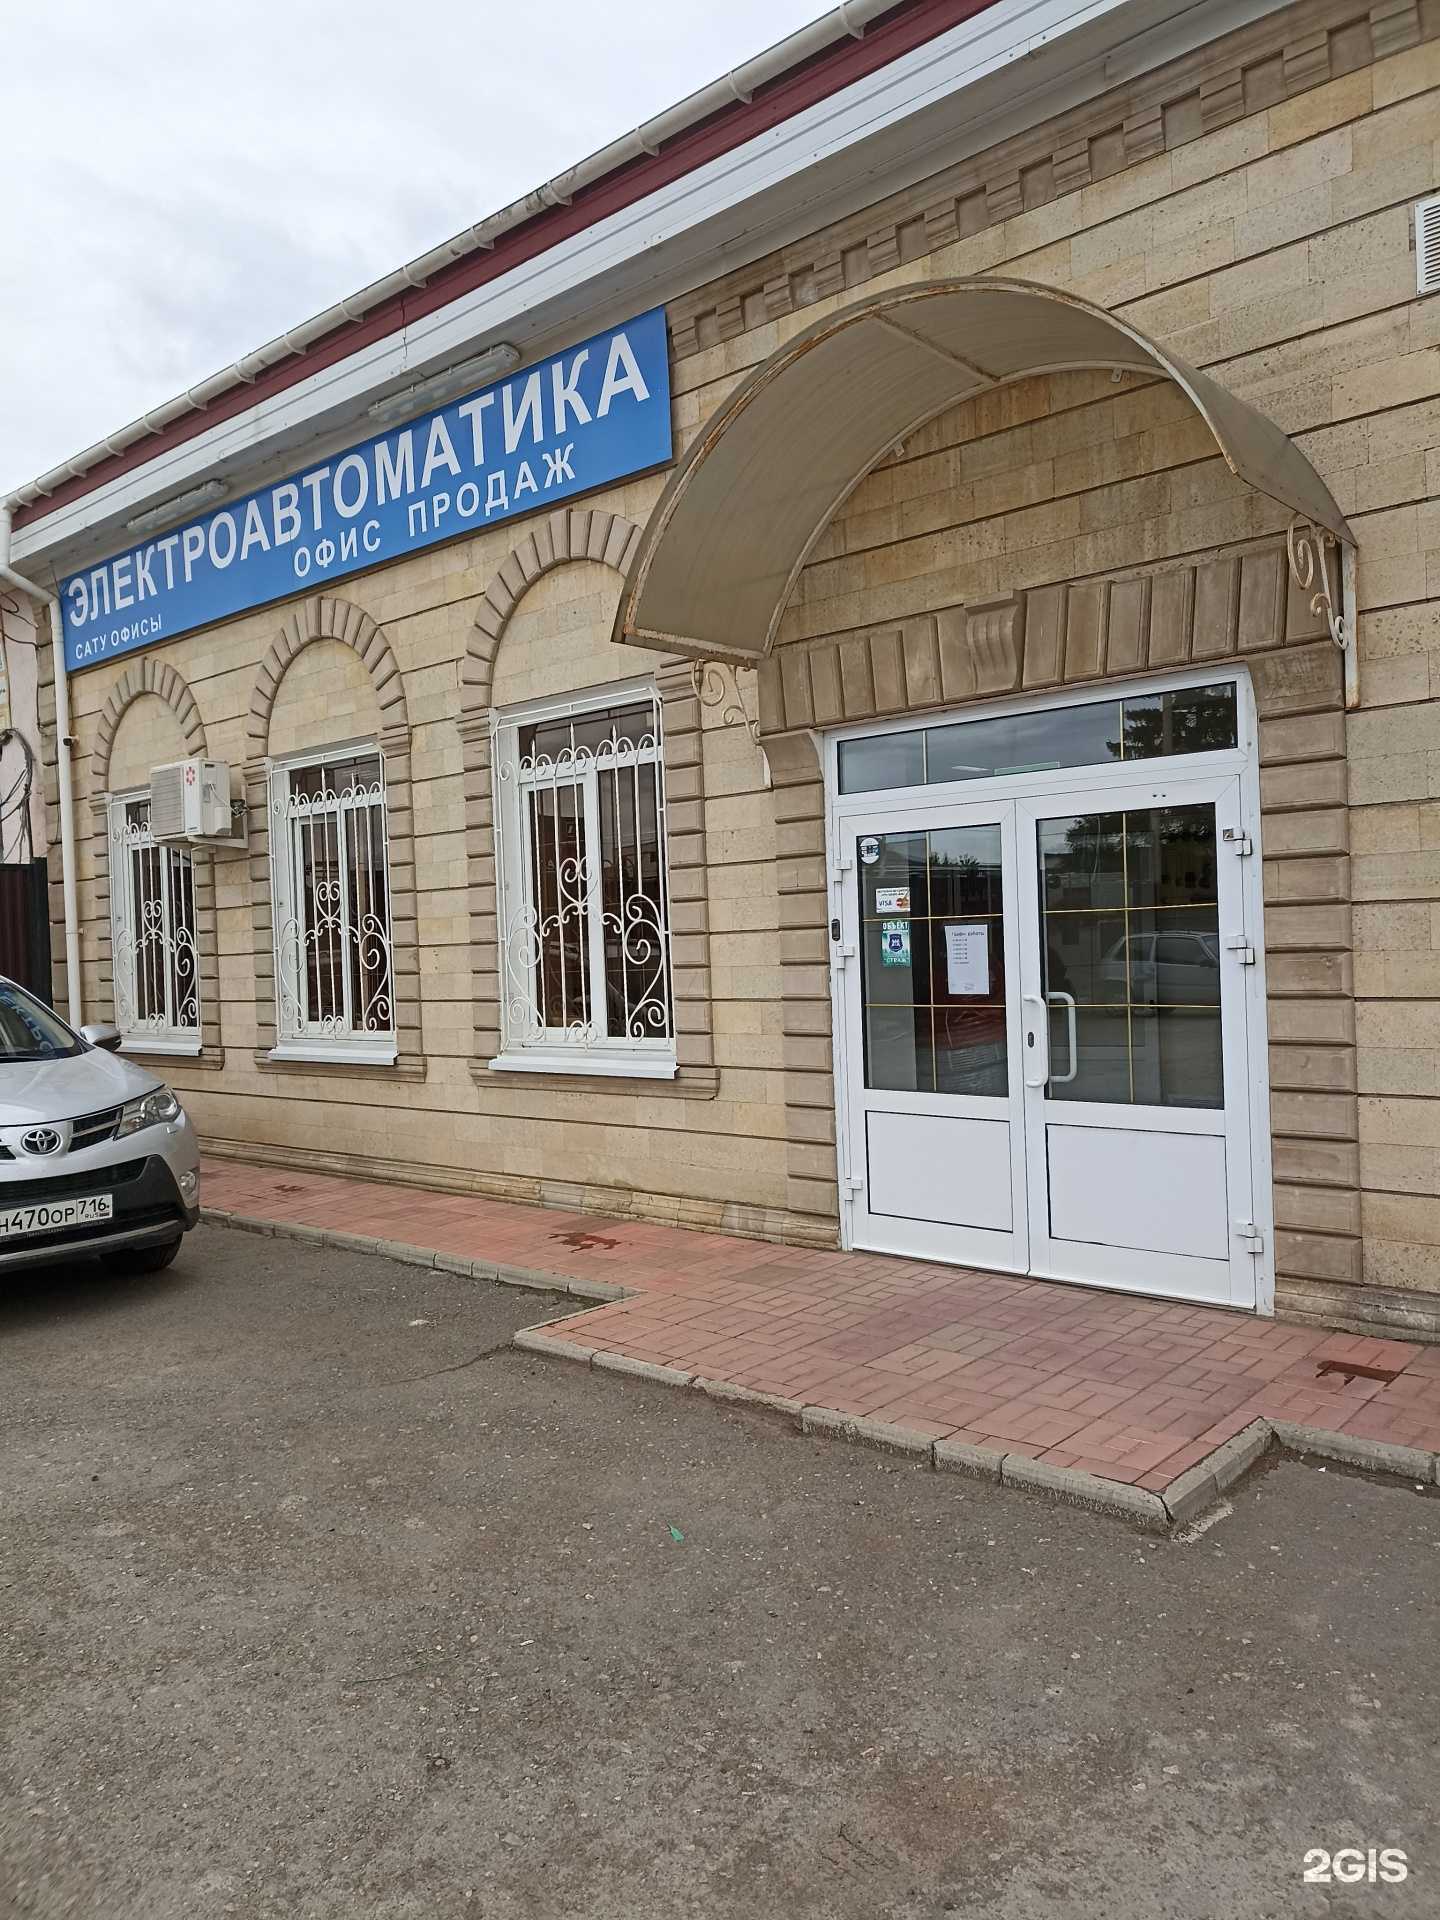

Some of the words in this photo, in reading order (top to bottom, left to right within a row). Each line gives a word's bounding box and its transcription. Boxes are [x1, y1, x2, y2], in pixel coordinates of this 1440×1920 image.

[68, 332, 650, 627] ЭЛЕКТРОАВТОМАТИКА
[294, 519, 381, 578] ОФИС
[408, 443, 576, 537] ПРОДАЖ
[75, 635, 107, 660] САТУ
[111, 614, 162, 646] ОФИСЫ
[78, 1198, 106, 1215] 716
